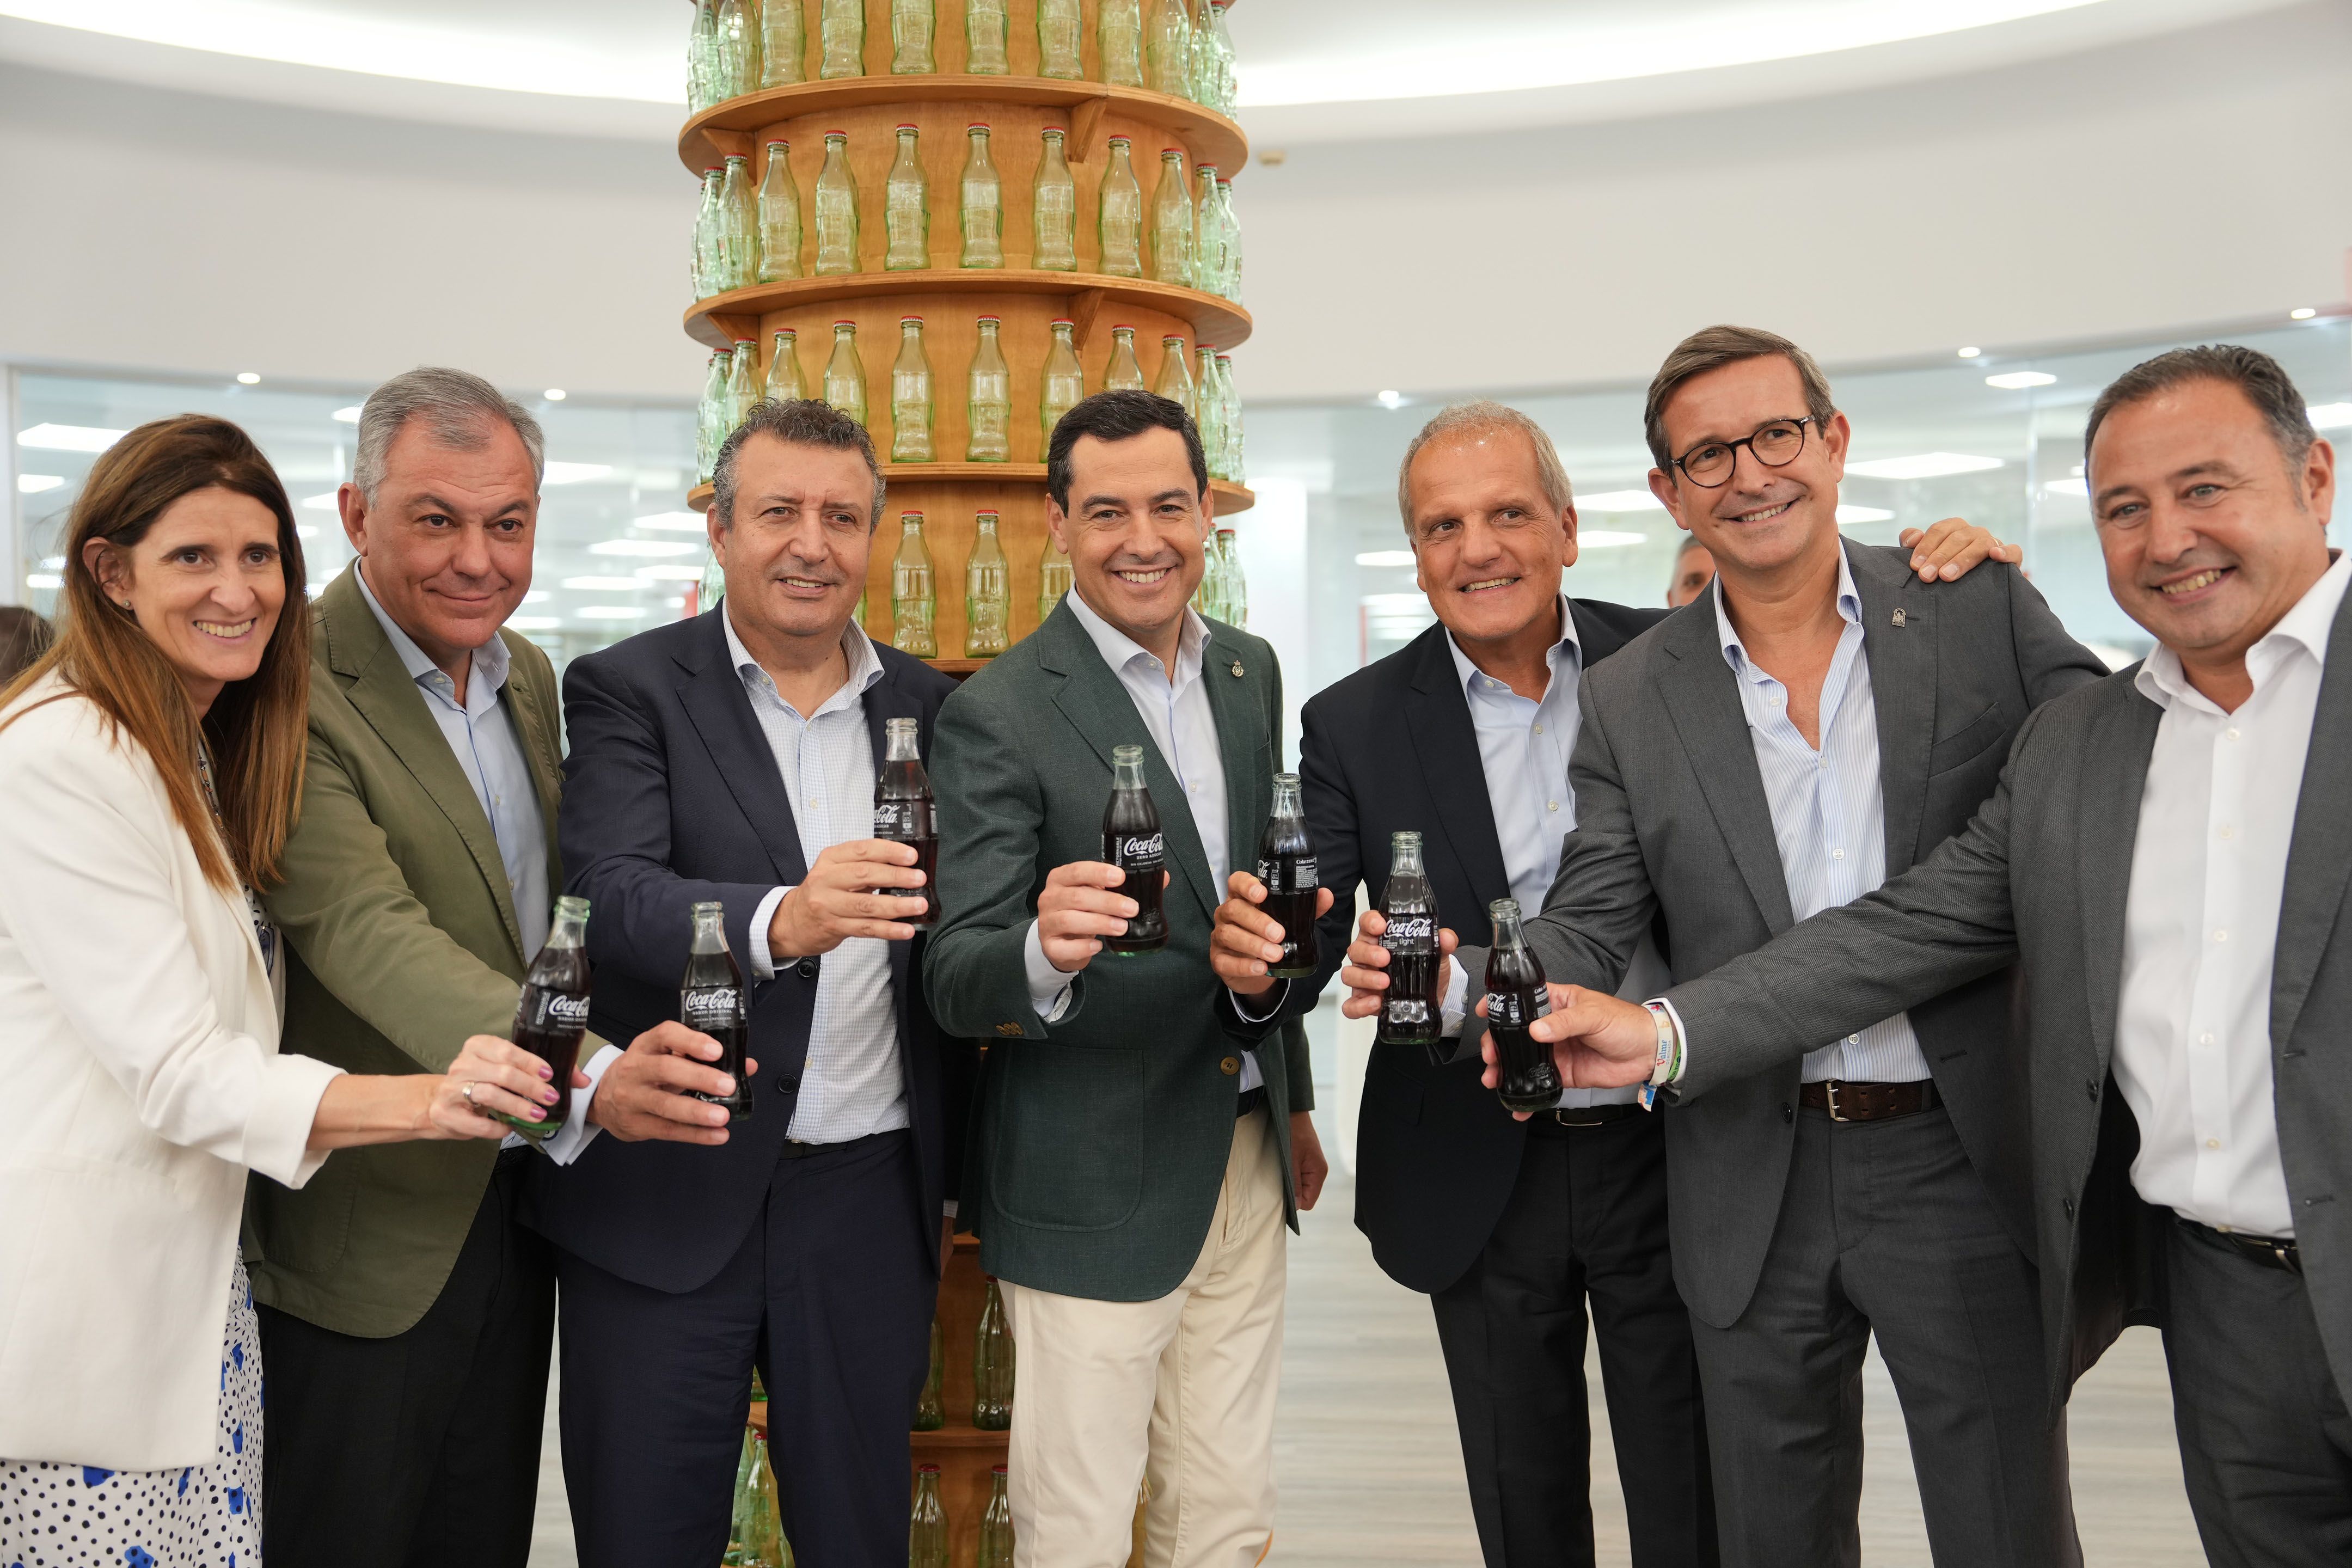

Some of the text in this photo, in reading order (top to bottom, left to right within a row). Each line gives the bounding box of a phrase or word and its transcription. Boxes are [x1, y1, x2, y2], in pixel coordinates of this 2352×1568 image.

[874, 805, 901, 823] Cola
[1124, 833, 1163, 856] Coca-Cola
[1385, 918, 1432, 938] Coca-Cola
[1399, 938, 1414, 946] light
[686, 989, 737, 1012] Coca-Cola
[1487, 993, 1506, 1012] Cola
[1657, 1040, 1667, 1067] Valme
